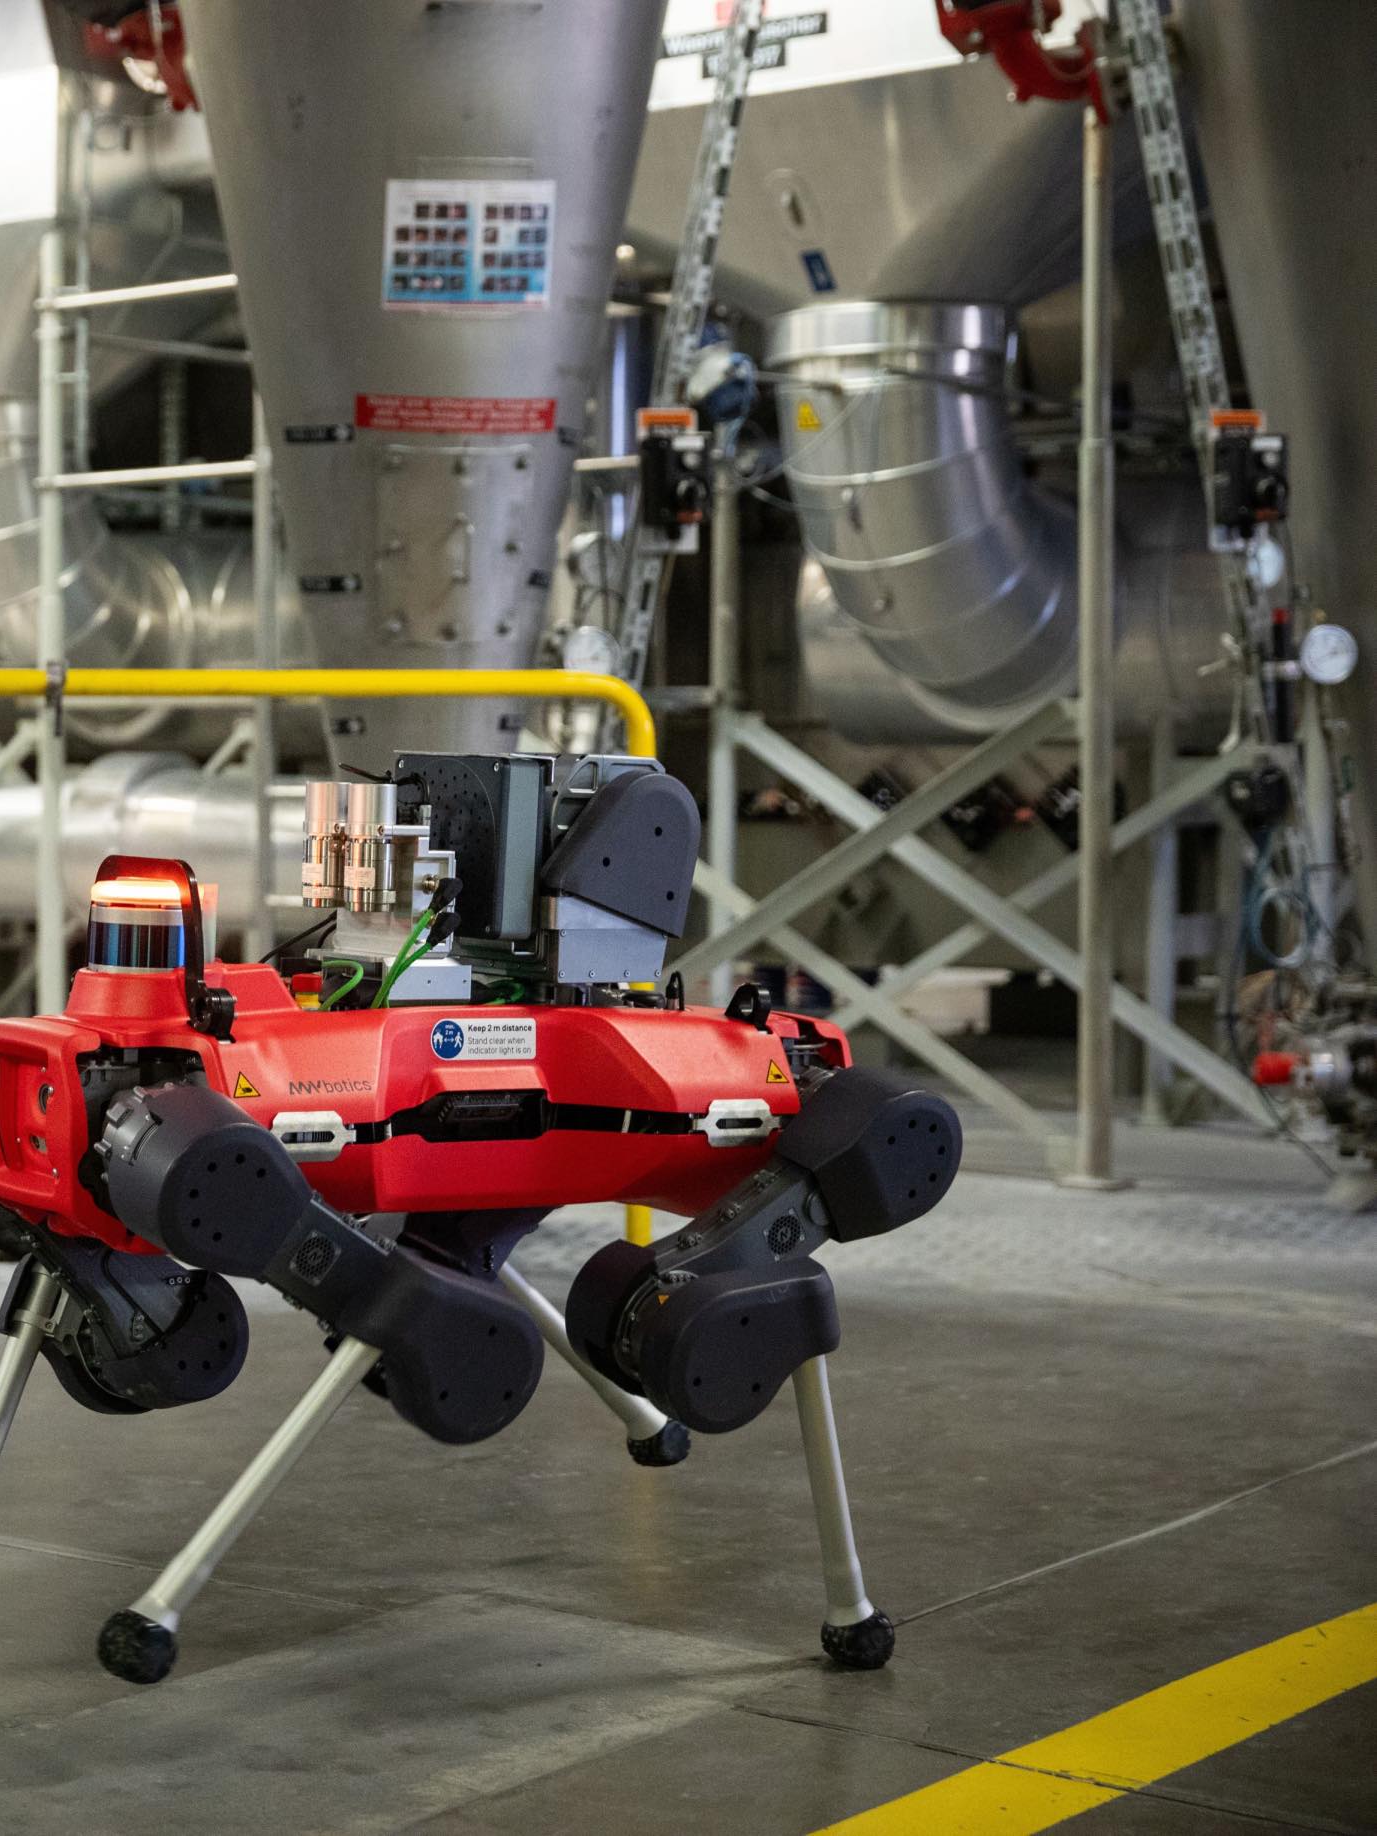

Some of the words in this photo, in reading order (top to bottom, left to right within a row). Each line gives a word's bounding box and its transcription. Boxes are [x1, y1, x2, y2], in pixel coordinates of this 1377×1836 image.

[468, 1025, 486, 1033] Keep
[502, 1024, 532, 1032] distance
[468, 1037, 488, 1045] Stand
[489, 1037, 506, 1045] clear
[468, 1046, 498, 1054] indicator
[499, 1046, 514, 1055] light
